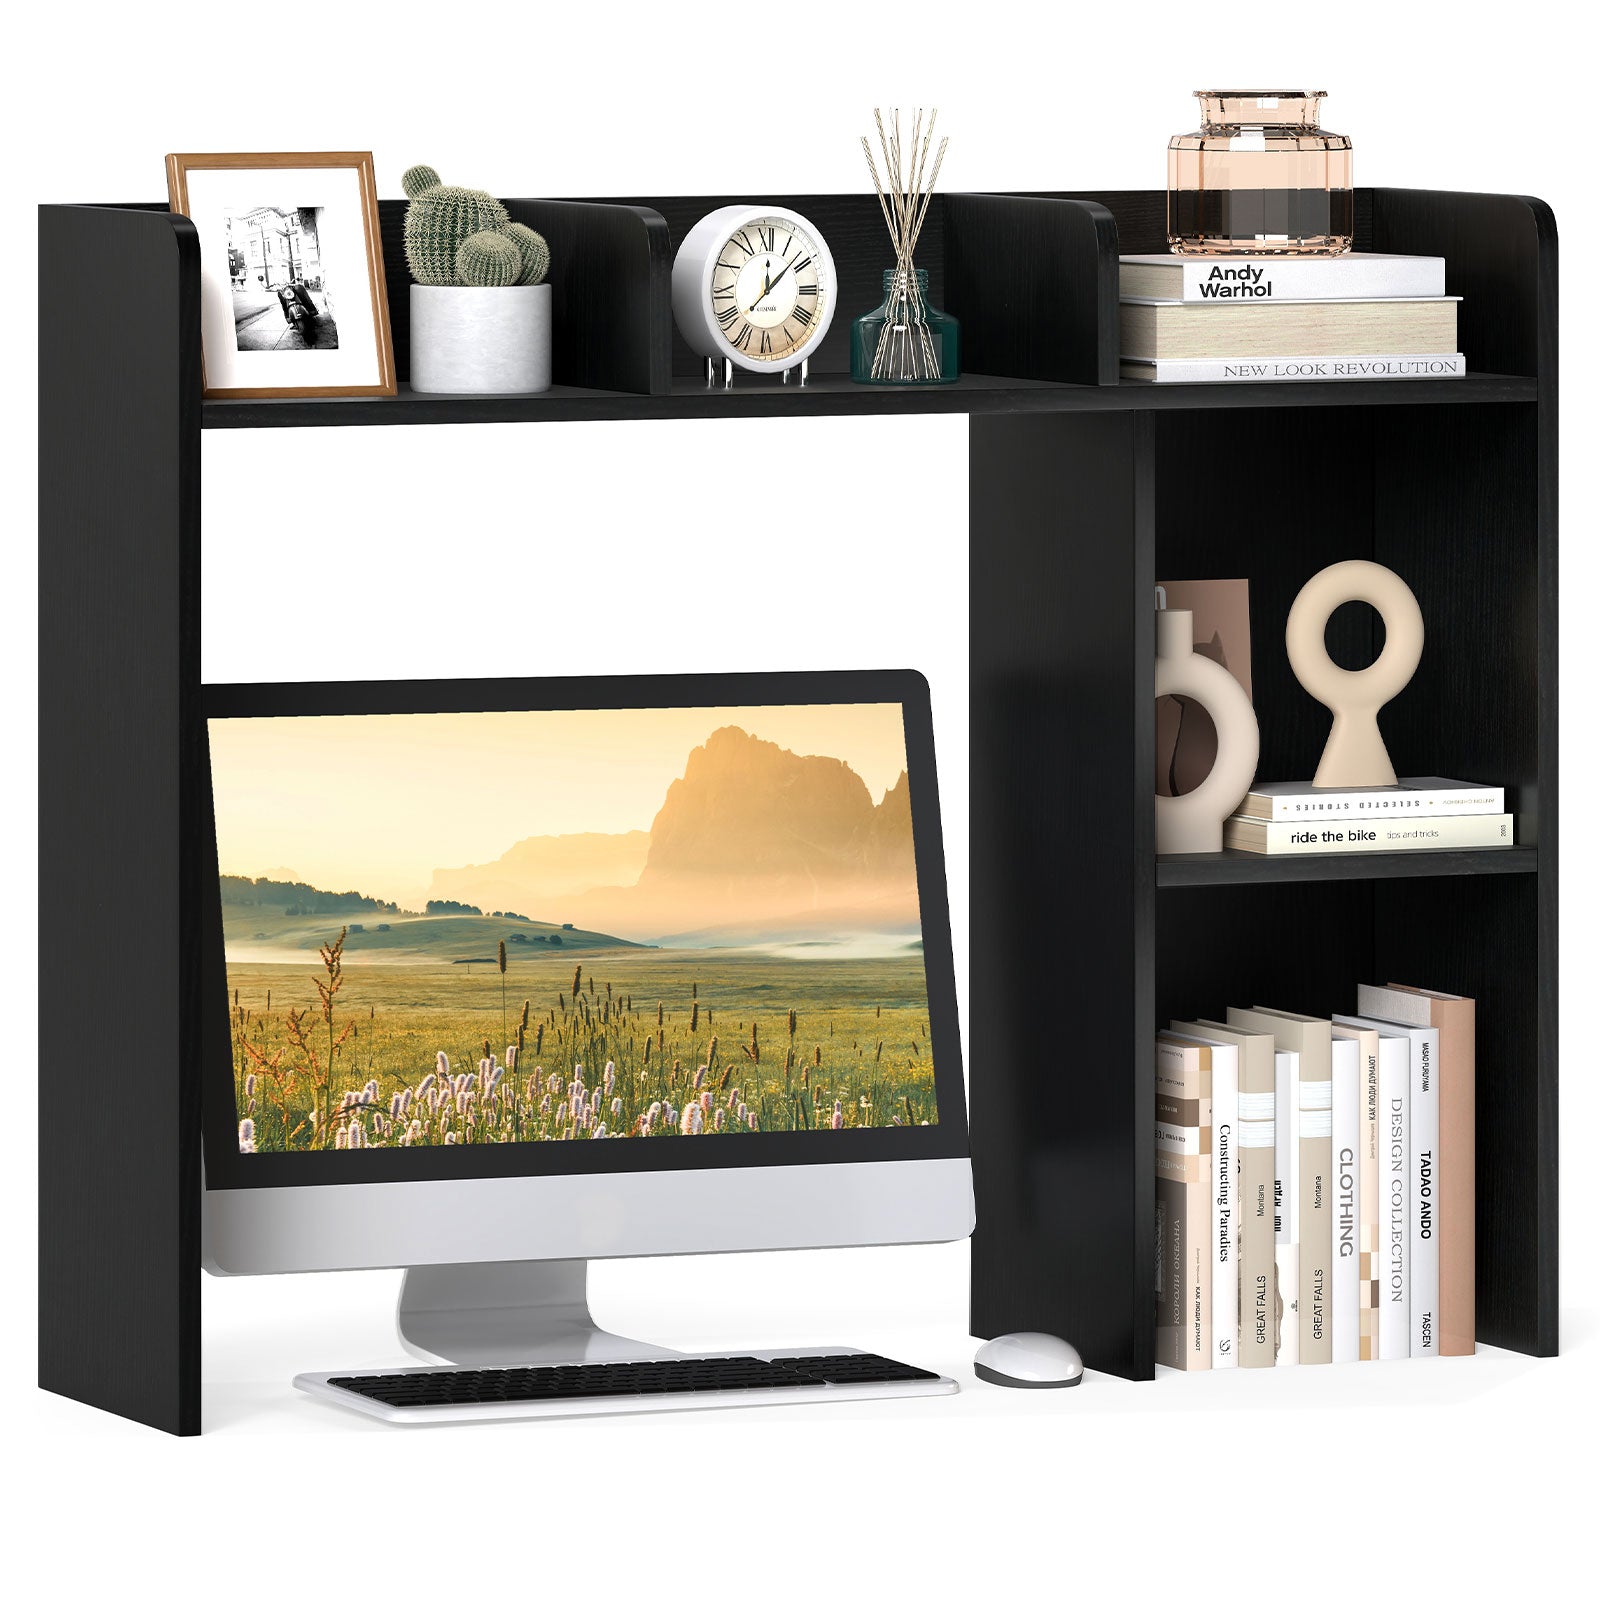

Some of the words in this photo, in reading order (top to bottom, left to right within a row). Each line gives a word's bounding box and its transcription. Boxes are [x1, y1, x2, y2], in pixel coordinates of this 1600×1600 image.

[1199, 281, 1272, 298] Warhol
[1208, 264, 1264, 284] Andy
[1224, 364, 1269, 377] NEW
[1274, 363, 1328, 377] LOOK
[1333, 361, 1458, 375] REVOLUTION
[1296, 802, 1349, 811] STORIES
[1359, 800, 1420, 809] SELECTED
[1291, 831, 1318, 844] ride
[1321, 830, 1344, 842] the
[1348, 829, 1377, 842] bike
[1387, 830, 1401, 839] tips
[1402, 829, 1418, 839] and
[1419, 829, 1439, 838] tricks
[1422, 1042, 1430, 1061] MASAO
[1368, 1055, 1377, 1085] ДУМАЮТ
[1422, 1062, 1430, 1092] FURUYAMA
[1368, 1086, 1377, 1106] ЛЮДИ
[1368, 1107, 1376, 1121] КАК
[1391, 1097, 1403, 1172] DESIGN
[1217, 1124, 1231, 1205] Constructing
[1420, 1150, 1432, 1198] TADAO
[1257, 1184, 1265, 1217] Montana
[1314, 1175, 1322, 1209] Montana
[1339, 1148, 1354, 1257] CLOTHING
[1220, 1209, 1231, 1262] Paradies
[1420, 1200, 1432, 1240] ANDO
[1173, 1219, 1181, 1270] ОКЕАНА
[1391, 1179, 1403, 1302] COLLECTION
[1173, 1274, 1181, 1325] КОРОЛИ
[1256, 1275, 1266, 1307] FALLS
[1313, 1269, 1323, 1301] FALLS
[1256, 1309, 1265, 1344] GREAT
[1313, 1304, 1323, 1340] GREAT
[1422, 1312, 1431, 1348] TASCEN
